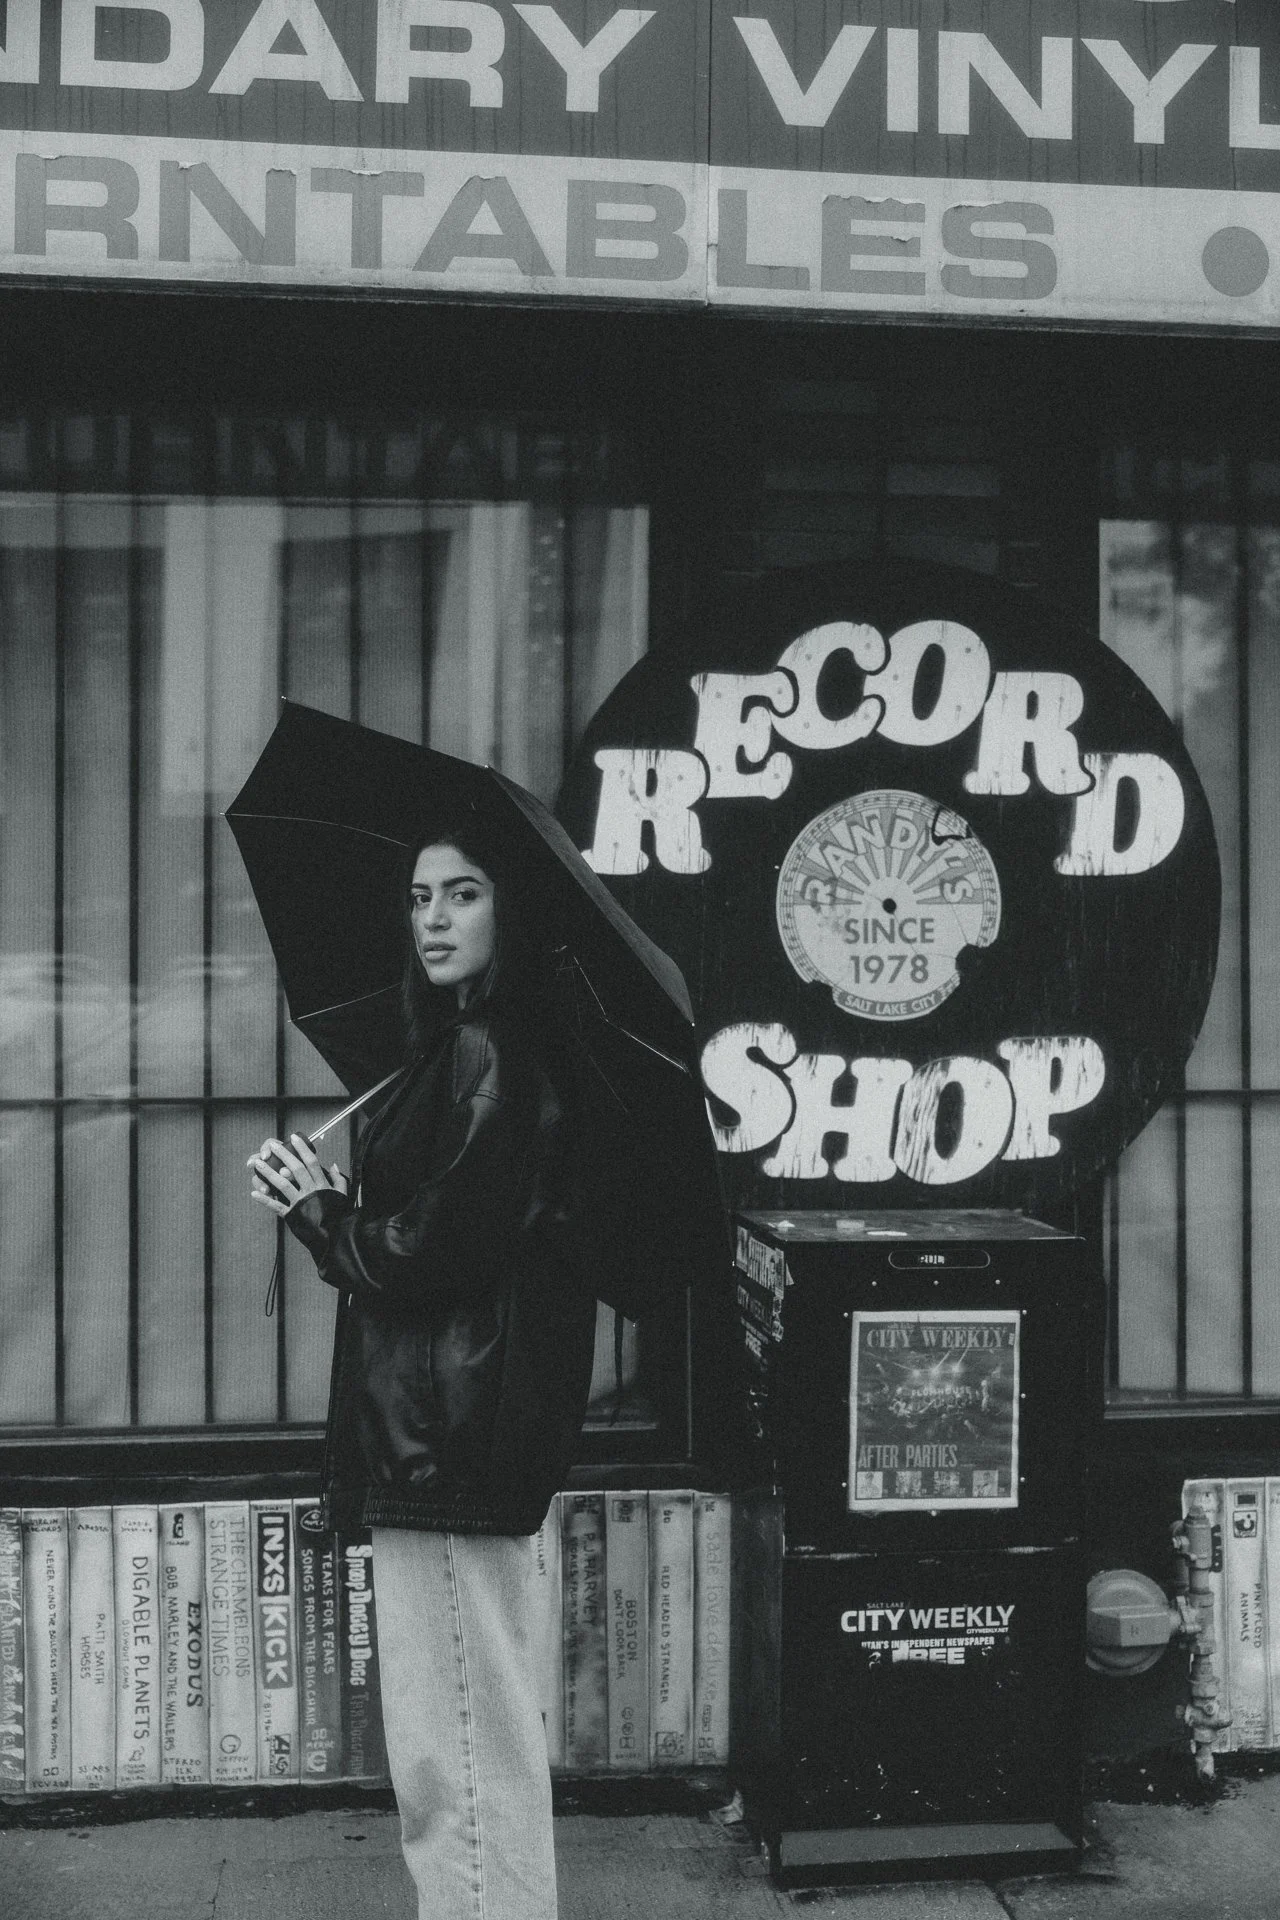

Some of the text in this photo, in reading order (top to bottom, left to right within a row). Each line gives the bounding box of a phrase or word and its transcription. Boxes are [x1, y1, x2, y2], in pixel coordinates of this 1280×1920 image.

[733, 17, 1280, 149] VINYL
[14, 153, 1057, 300] RNTABLES
[582, 620, 1184, 875] RECORD
[799, 808, 975, 906] RANDY'S
[844, 917, 935, 945] SINCE
[850, 954, 929, 984] 1978
[845, 994, 936, 1016] SALT LAKE CITY
[701, 1023, 1104, 1184] SHOP
[866, 1329, 914, 1348] CITY
[921, 1328, 1005, 1348] WEEKLY
[858, 1444, 958, 1468] AFTER PARTIES
[45, 1549, 56, 1581] NEVER
[262, 1516, 285, 1594] INXS
[705, 1531, 724, 1576] sade
[47, 1585, 58, 1610] MIND
[48, 1612, 57, 1627] THE
[209, 1520, 230, 1677] STRANGE TIMES
[232, 1554, 250, 1678] CHAMELEONS
[321, 1551, 335, 1675] TEARS FOR FEARS
[582, 1557, 599, 1627] HARVEY
[704, 1586, 724, 1630] love
[841, 1605, 1016, 1633] CITY WEEKLY
[1240, 1592, 1250, 1642] ANIMALS
[1253, 1582, 1262, 1649] PINK FLOYD
[80, 1636, 91, 1679] HORSES
[132, 1556, 150, 1740] DIGABLE PLANETS
[164, 1566, 179, 1751] BOB MARLEY AND THE WAILERS
[187, 1601, 204, 1708] EXODUS
[263, 1605, 288, 1684] KICK
[301, 1548, 316, 1725] SONGS FROM THE BIG CHAIR
[615, 1621, 626, 1651] LOOK
[625, 1598, 638, 1662] BOSTON
[659, 1565, 671, 1704] RED HEADED STRANGER
[891, 1638, 946, 1649] INDEPENDENT
[946, 1636, 995, 1647] NEWSPAPER
[94, 1650, 105, 1684] SMITH
